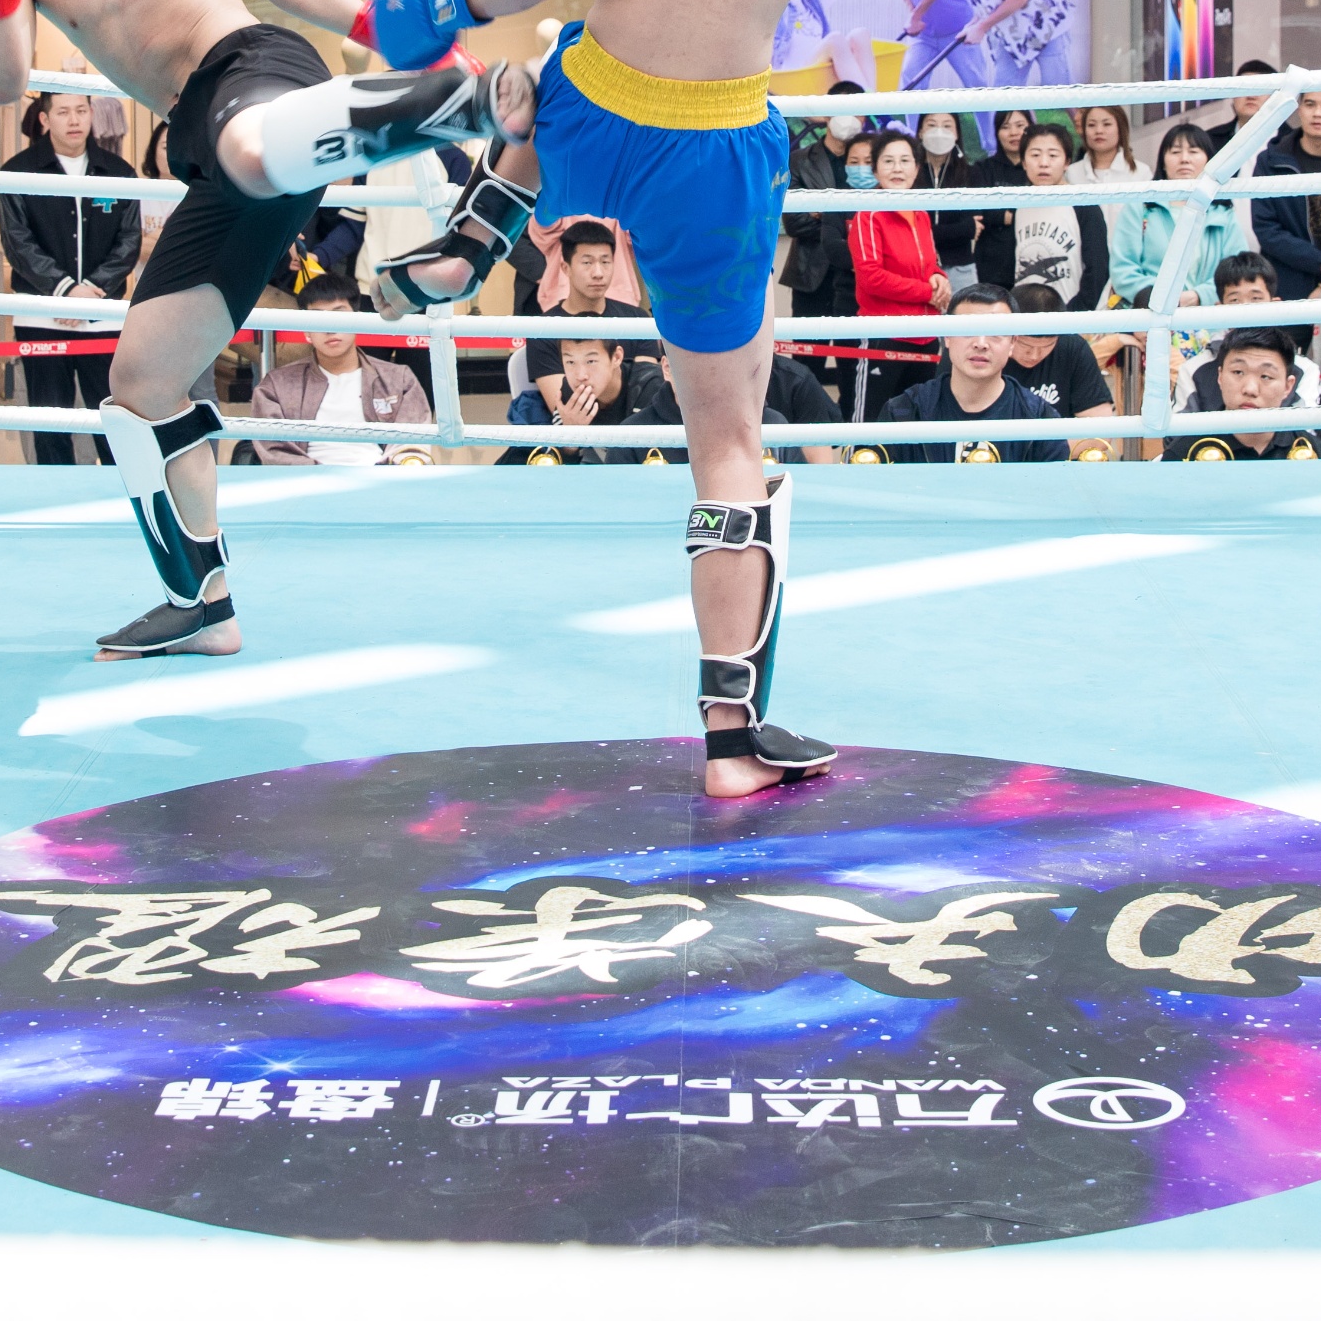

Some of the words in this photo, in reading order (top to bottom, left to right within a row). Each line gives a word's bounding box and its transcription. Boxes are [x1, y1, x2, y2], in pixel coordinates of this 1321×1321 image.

[1018, 221, 1076, 254] THUSIASM
[155, 1079, 403, 1121] 盘锦
[500, 1077, 733, 1090] PLAZA
[753, 1078, 1008, 1092] WANDA
[493, 1088, 1018, 1128] 万达广场
